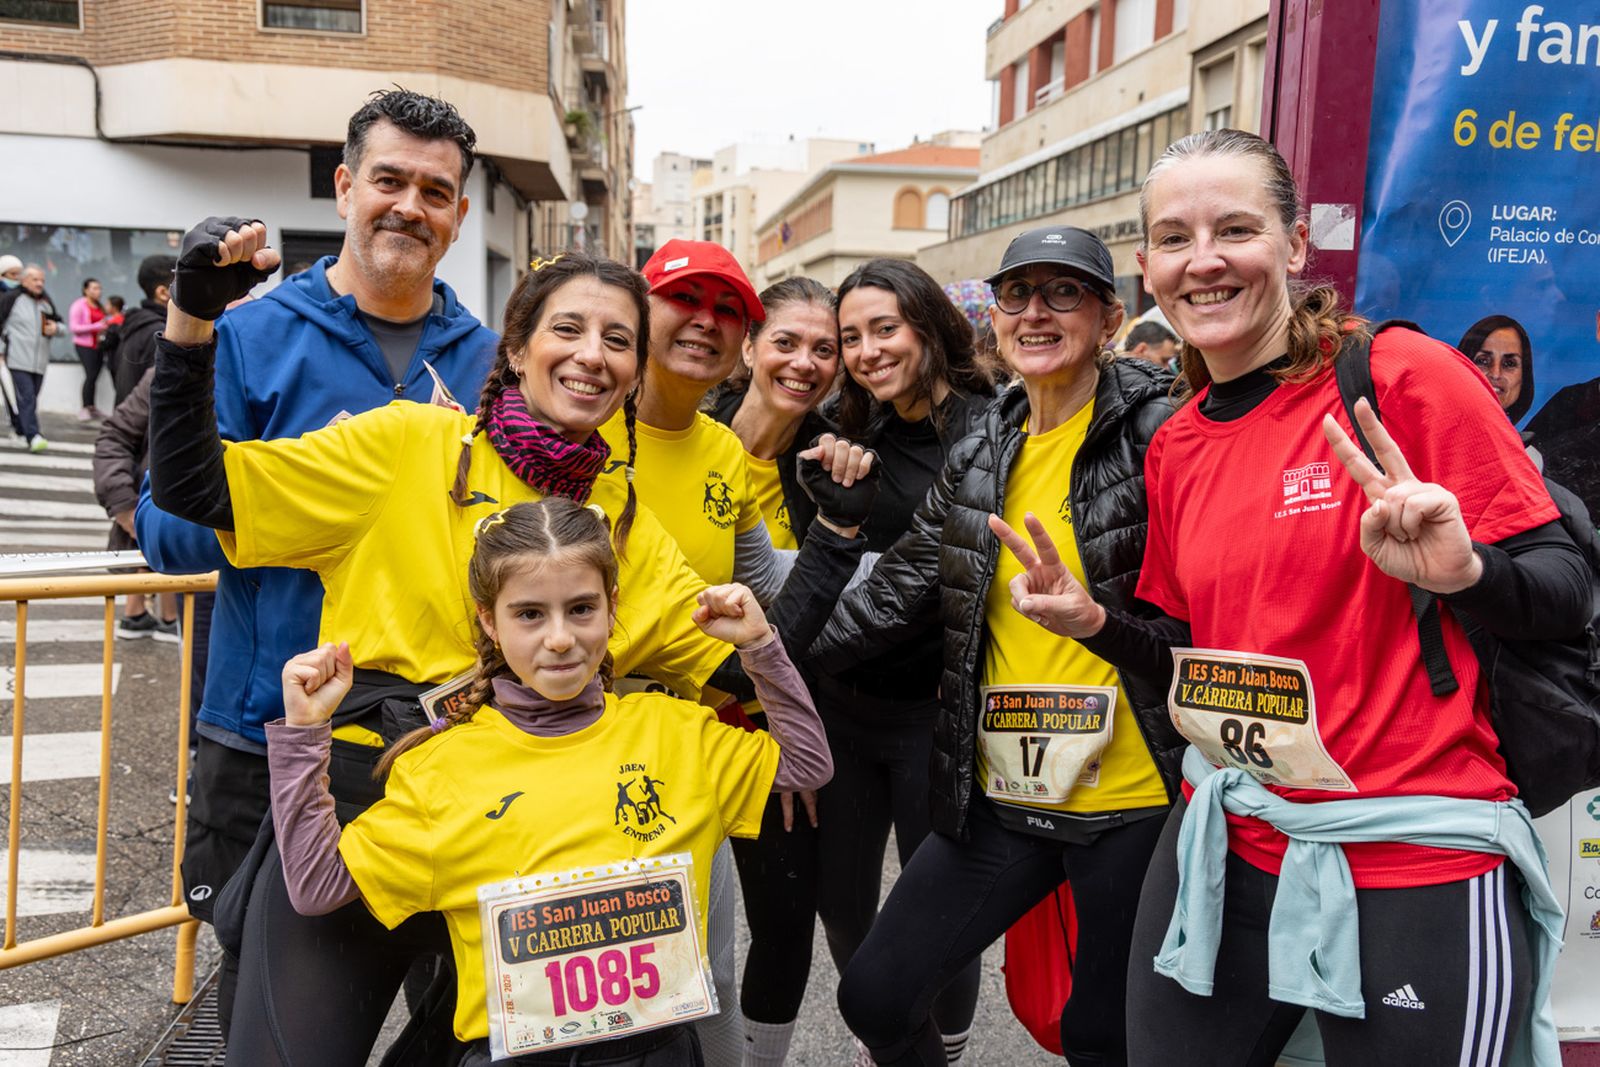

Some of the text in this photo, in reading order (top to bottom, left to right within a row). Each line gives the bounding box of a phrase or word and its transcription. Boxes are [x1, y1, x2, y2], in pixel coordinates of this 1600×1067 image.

[1457, 19, 1499, 76] y
[1453, 109, 1478, 147] 6
[1488, 110, 1541, 150] de
[1492, 205, 1557, 221] LUGAR:
[1490, 226, 1550, 243] Palacio
[1554, 228, 1575, 243] de
[1487, 247, 1548, 264] (IFEJA).
[1321, 501, 1341, 510] Bosco
[1188, 663, 1299, 691] IES San Juan Bosco
[1003, 695, 1022, 709] San
[1025, 694, 1054, 709] Juan
[1059, 694, 1086, 709] Bos
[1181, 684, 1304, 719] V CARRERA POPULAR
[986, 712, 1101, 730] V CARRERA POPULAR
[1220, 718, 1274, 768] 86
[1020, 736, 1051, 777] 17
[619, 763, 646, 774] JAEN
[622, 823, 666, 842] ENTRENA
[1026, 816, 1055, 831] FILA
[1582, 842, 1600, 854] Ra
[510, 887, 671, 932] IES San Juan Bosco
[508, 906, 680, 958] V CARRERA POPULAR
[544, 942, 661, 1018] 1085
[1382, 996, 1425, 1009] adidas
